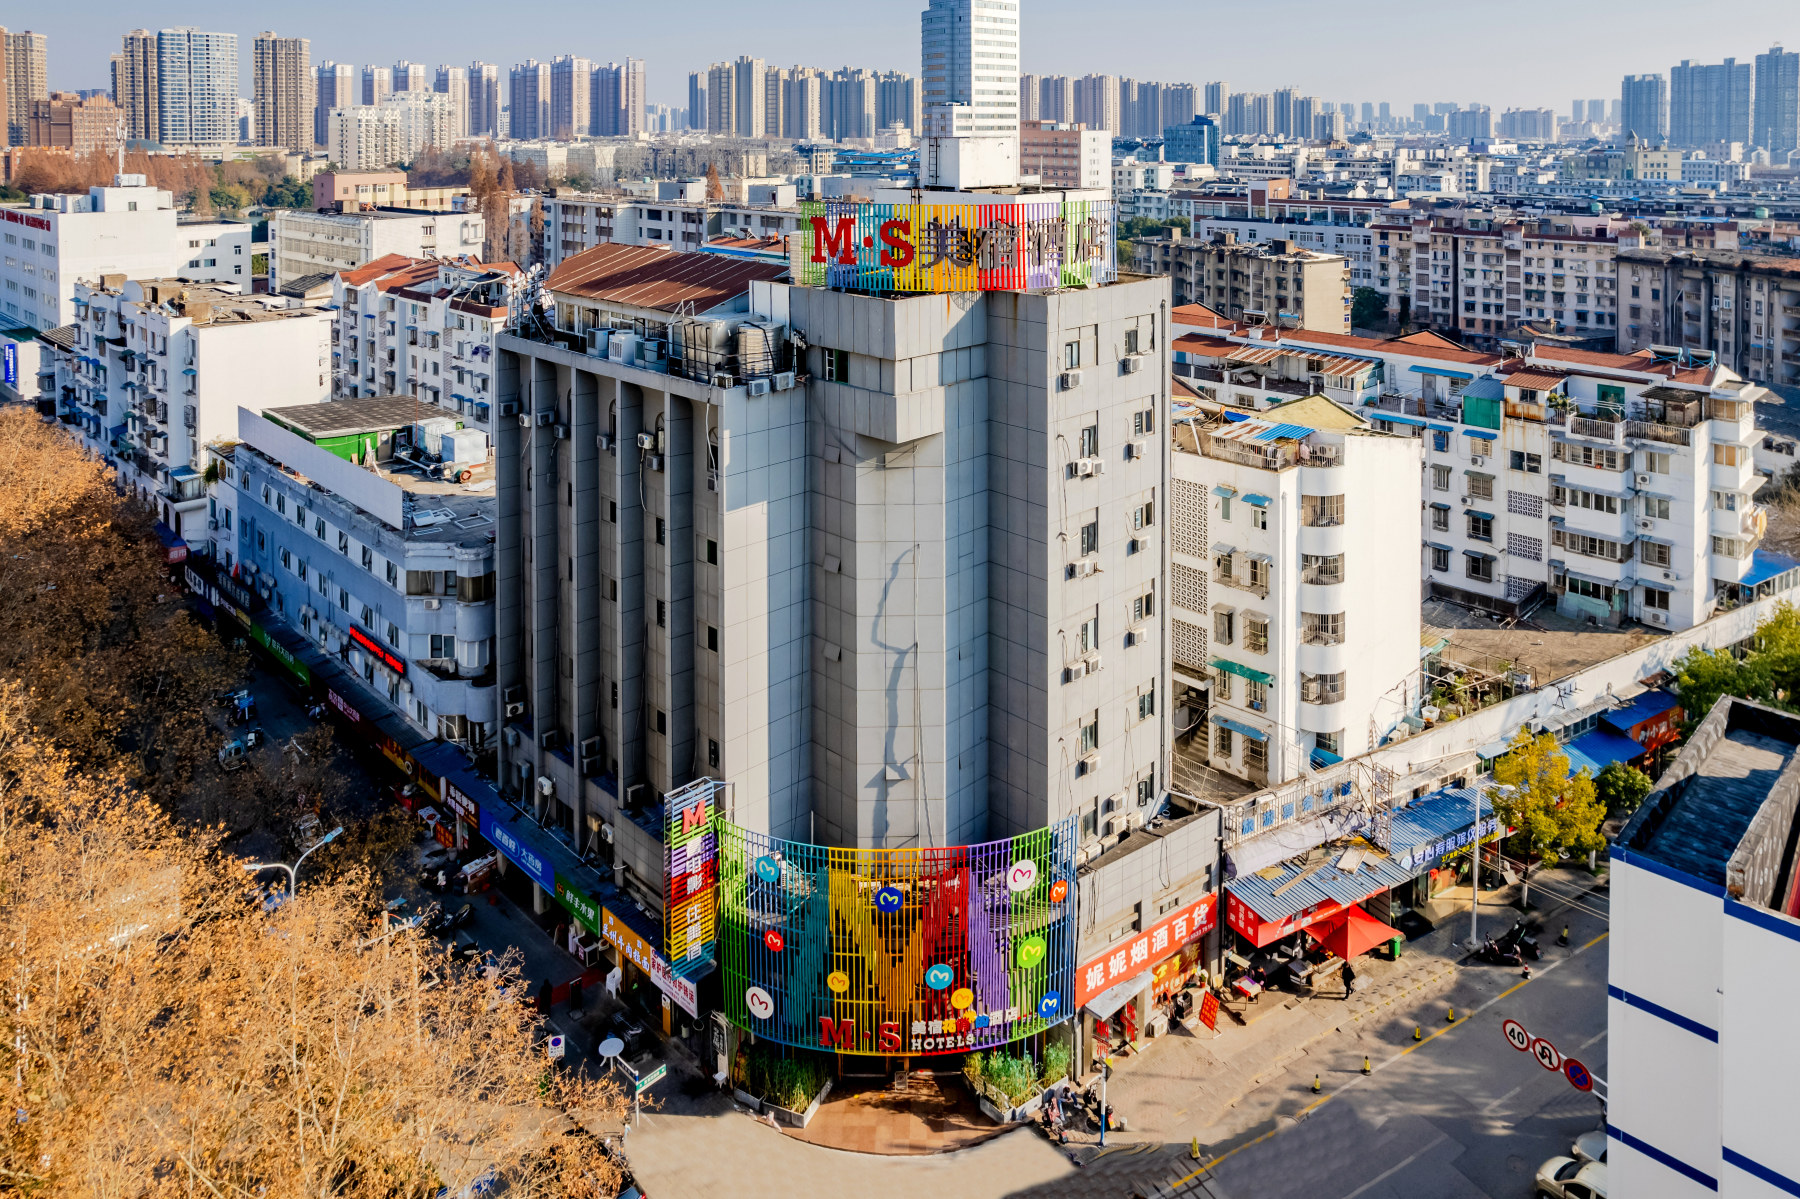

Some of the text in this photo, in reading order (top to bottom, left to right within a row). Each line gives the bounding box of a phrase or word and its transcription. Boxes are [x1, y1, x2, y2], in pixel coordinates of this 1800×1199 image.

[919, 215, 1110, 269] 美宿酒店
[682, 800, 706, 834] M
[565, 889, 595, 921] 鲜丰水果
[602, 923, 650, 972] 兰州牛肉拉面
[1086, 903, 1209, 992] 妮妮烟酒百货
[911, 1033, 976, 1050] HOTELS
[1508, 1027, 1525, 1045] 40
